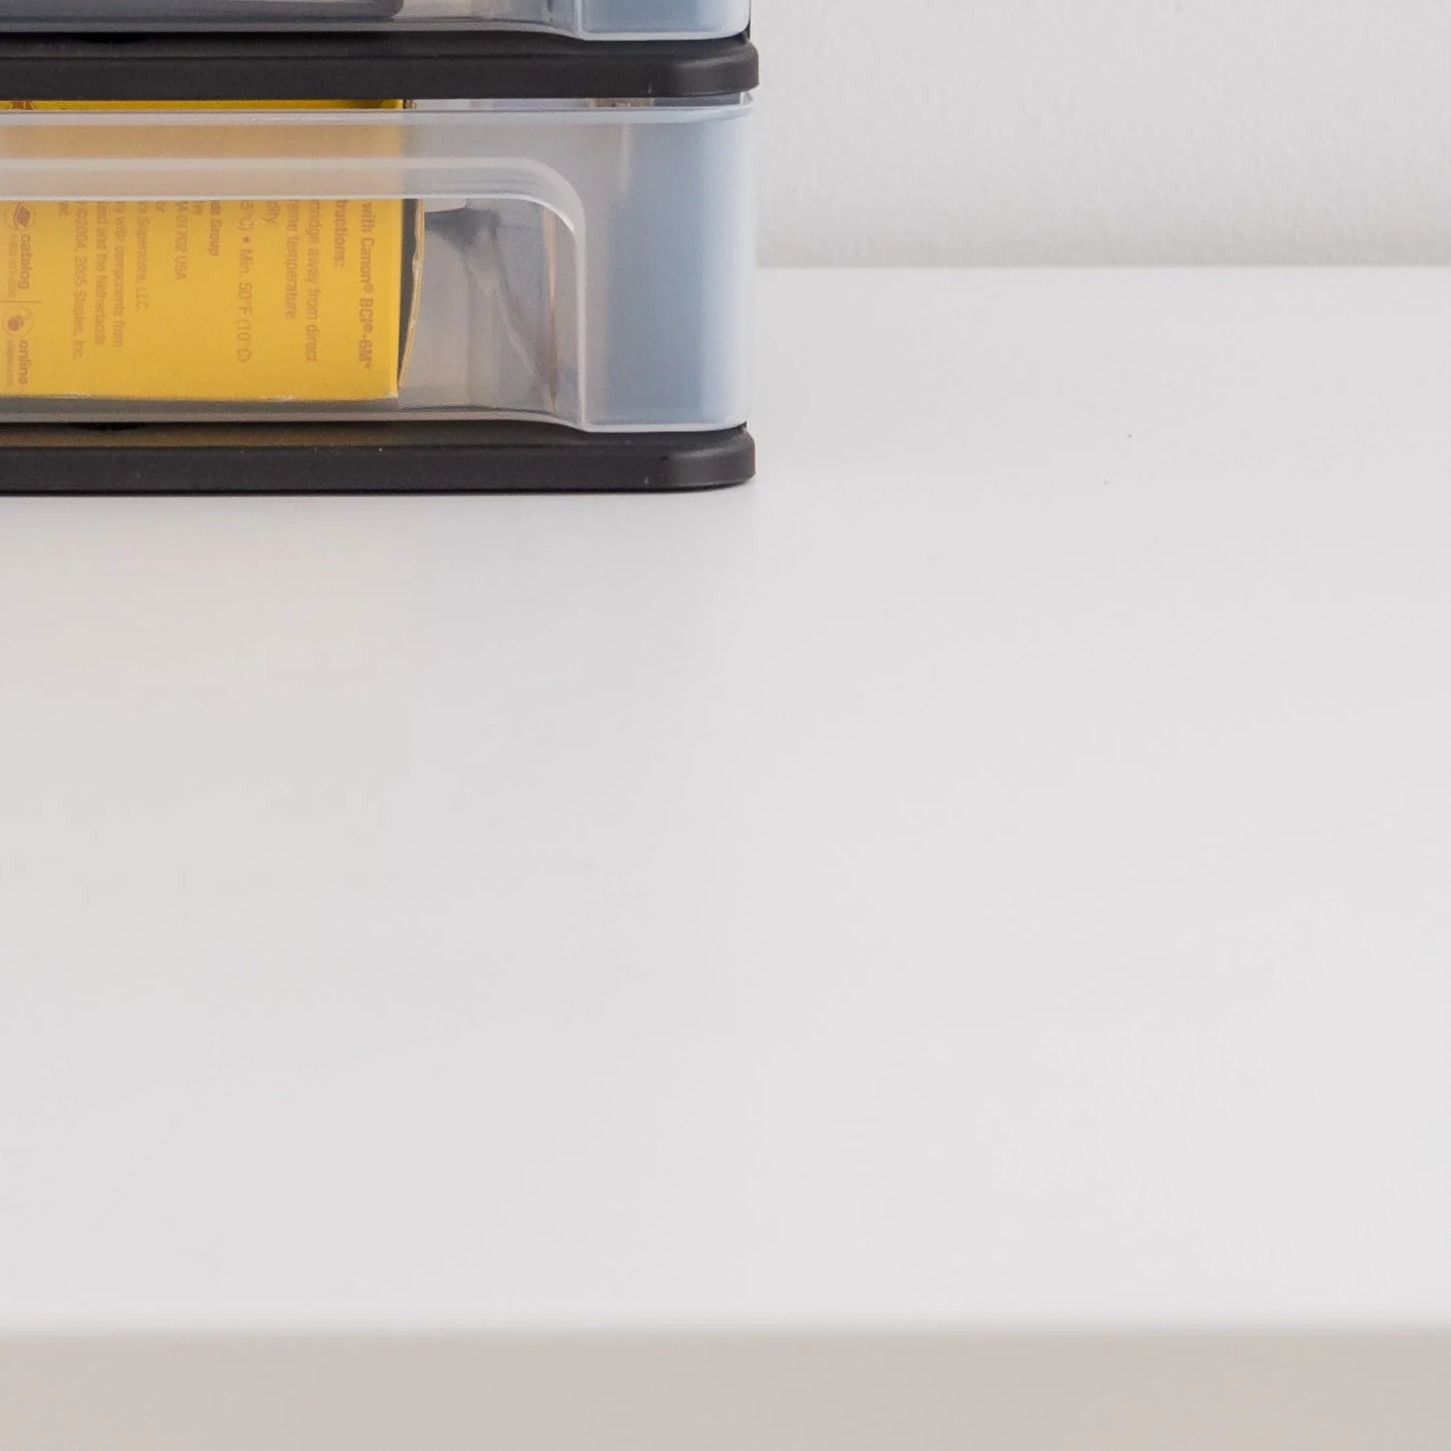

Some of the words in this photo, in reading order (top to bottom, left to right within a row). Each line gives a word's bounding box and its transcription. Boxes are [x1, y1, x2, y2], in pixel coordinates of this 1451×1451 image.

[115, 217, 127, 242] with
[175, 215, 187, 252] 01702
[361, 203, 375, 232] with
[97, 228, 107, 249] and
[207, 219, 221, 256] Group
[18, 234, 32, 289] catalog
[97, 254, 107, 271] the
[175, 256, 187, 280] USA
[239, 248, 253, 278] Min.
[284, 236, 300, 319] temperature
[305, 248, 319, 284] away
[112, 246, 125, 316] components
[307, 289, 321, 320] from
[113, 321, 126, 347] from
[306, 325, 320, 362] direct
[18, 340, 32, 385] online
